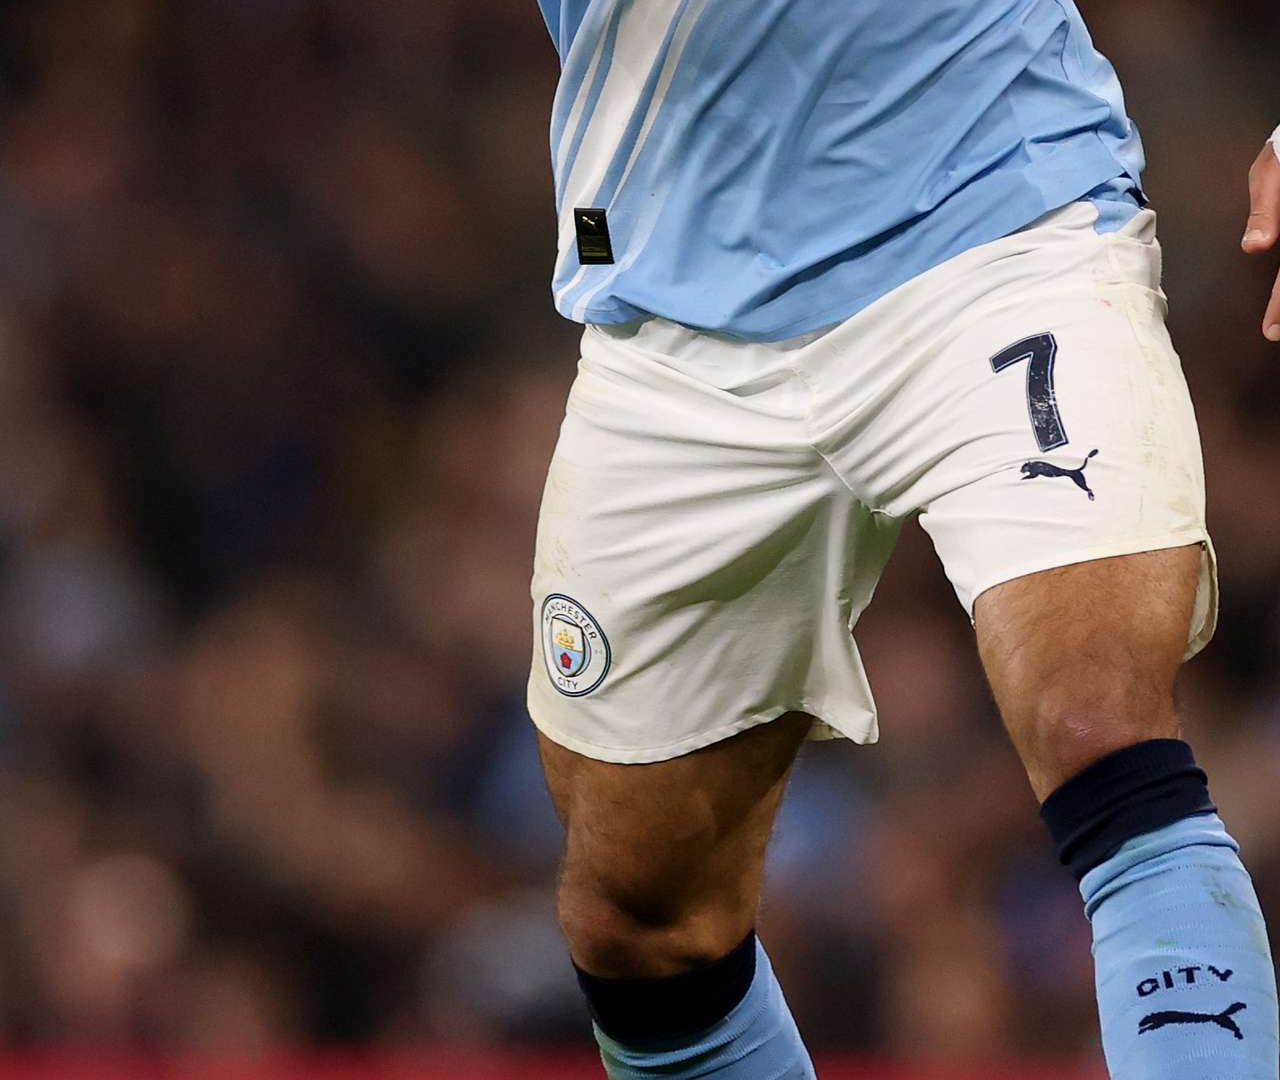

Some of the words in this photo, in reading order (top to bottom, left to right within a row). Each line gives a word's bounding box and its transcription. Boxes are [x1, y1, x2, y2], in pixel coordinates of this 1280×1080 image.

[989, 331, 1069, 452] 7
[557, 677, 578, 690] CITY
[1136, 966, 1233, 997] CITY
